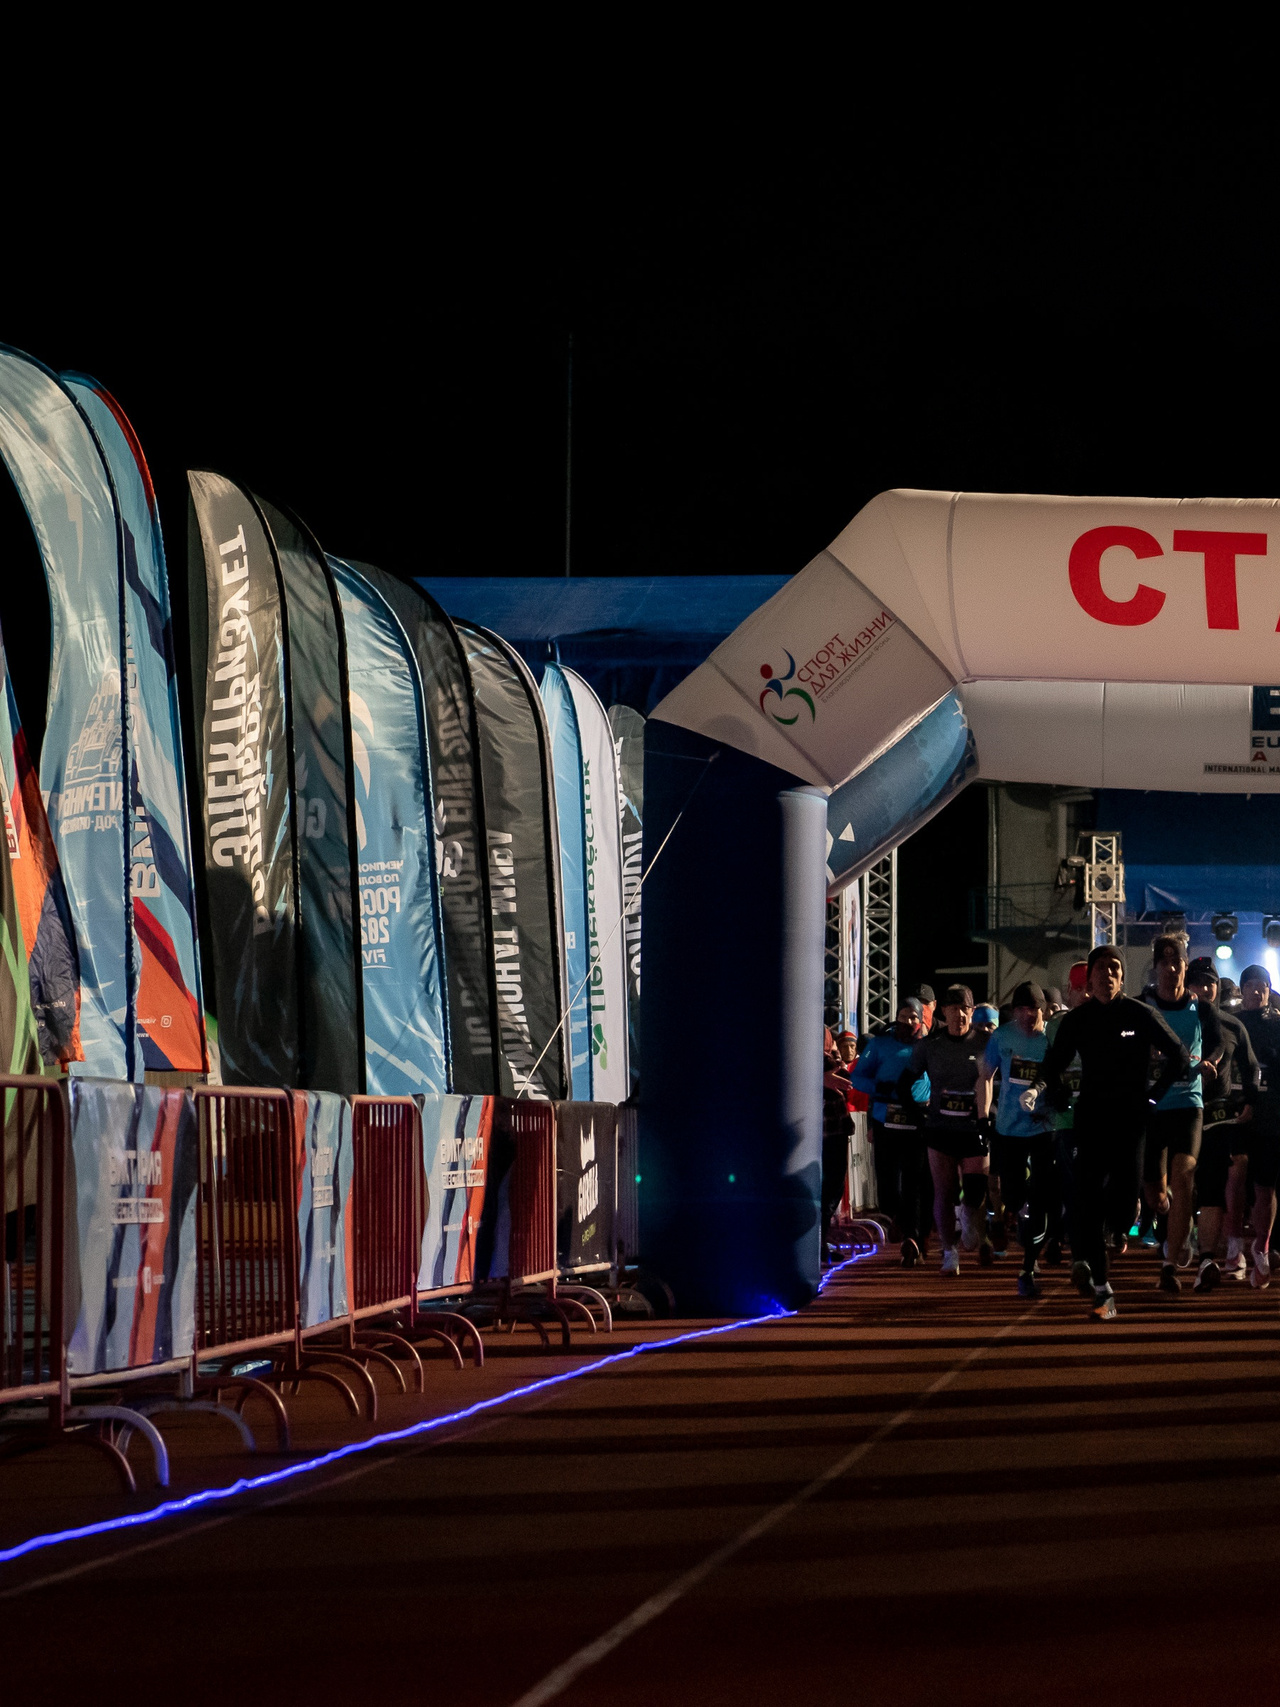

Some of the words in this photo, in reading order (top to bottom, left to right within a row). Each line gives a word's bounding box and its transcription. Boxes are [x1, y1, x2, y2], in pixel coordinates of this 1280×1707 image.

[797, 633, 845, 683] СПОРТ
[810, 663, 840, 695] ДЛЯ
[836, 611, 893, 667] ЖИЗНИ
[1204, 765, 1265, 774] INTERNATIONAL
[1018, 1067, 1037, 1080] 115
[946, 1101, 965, 1110] 471
[1211, 1110, 1226, 1121] 10
